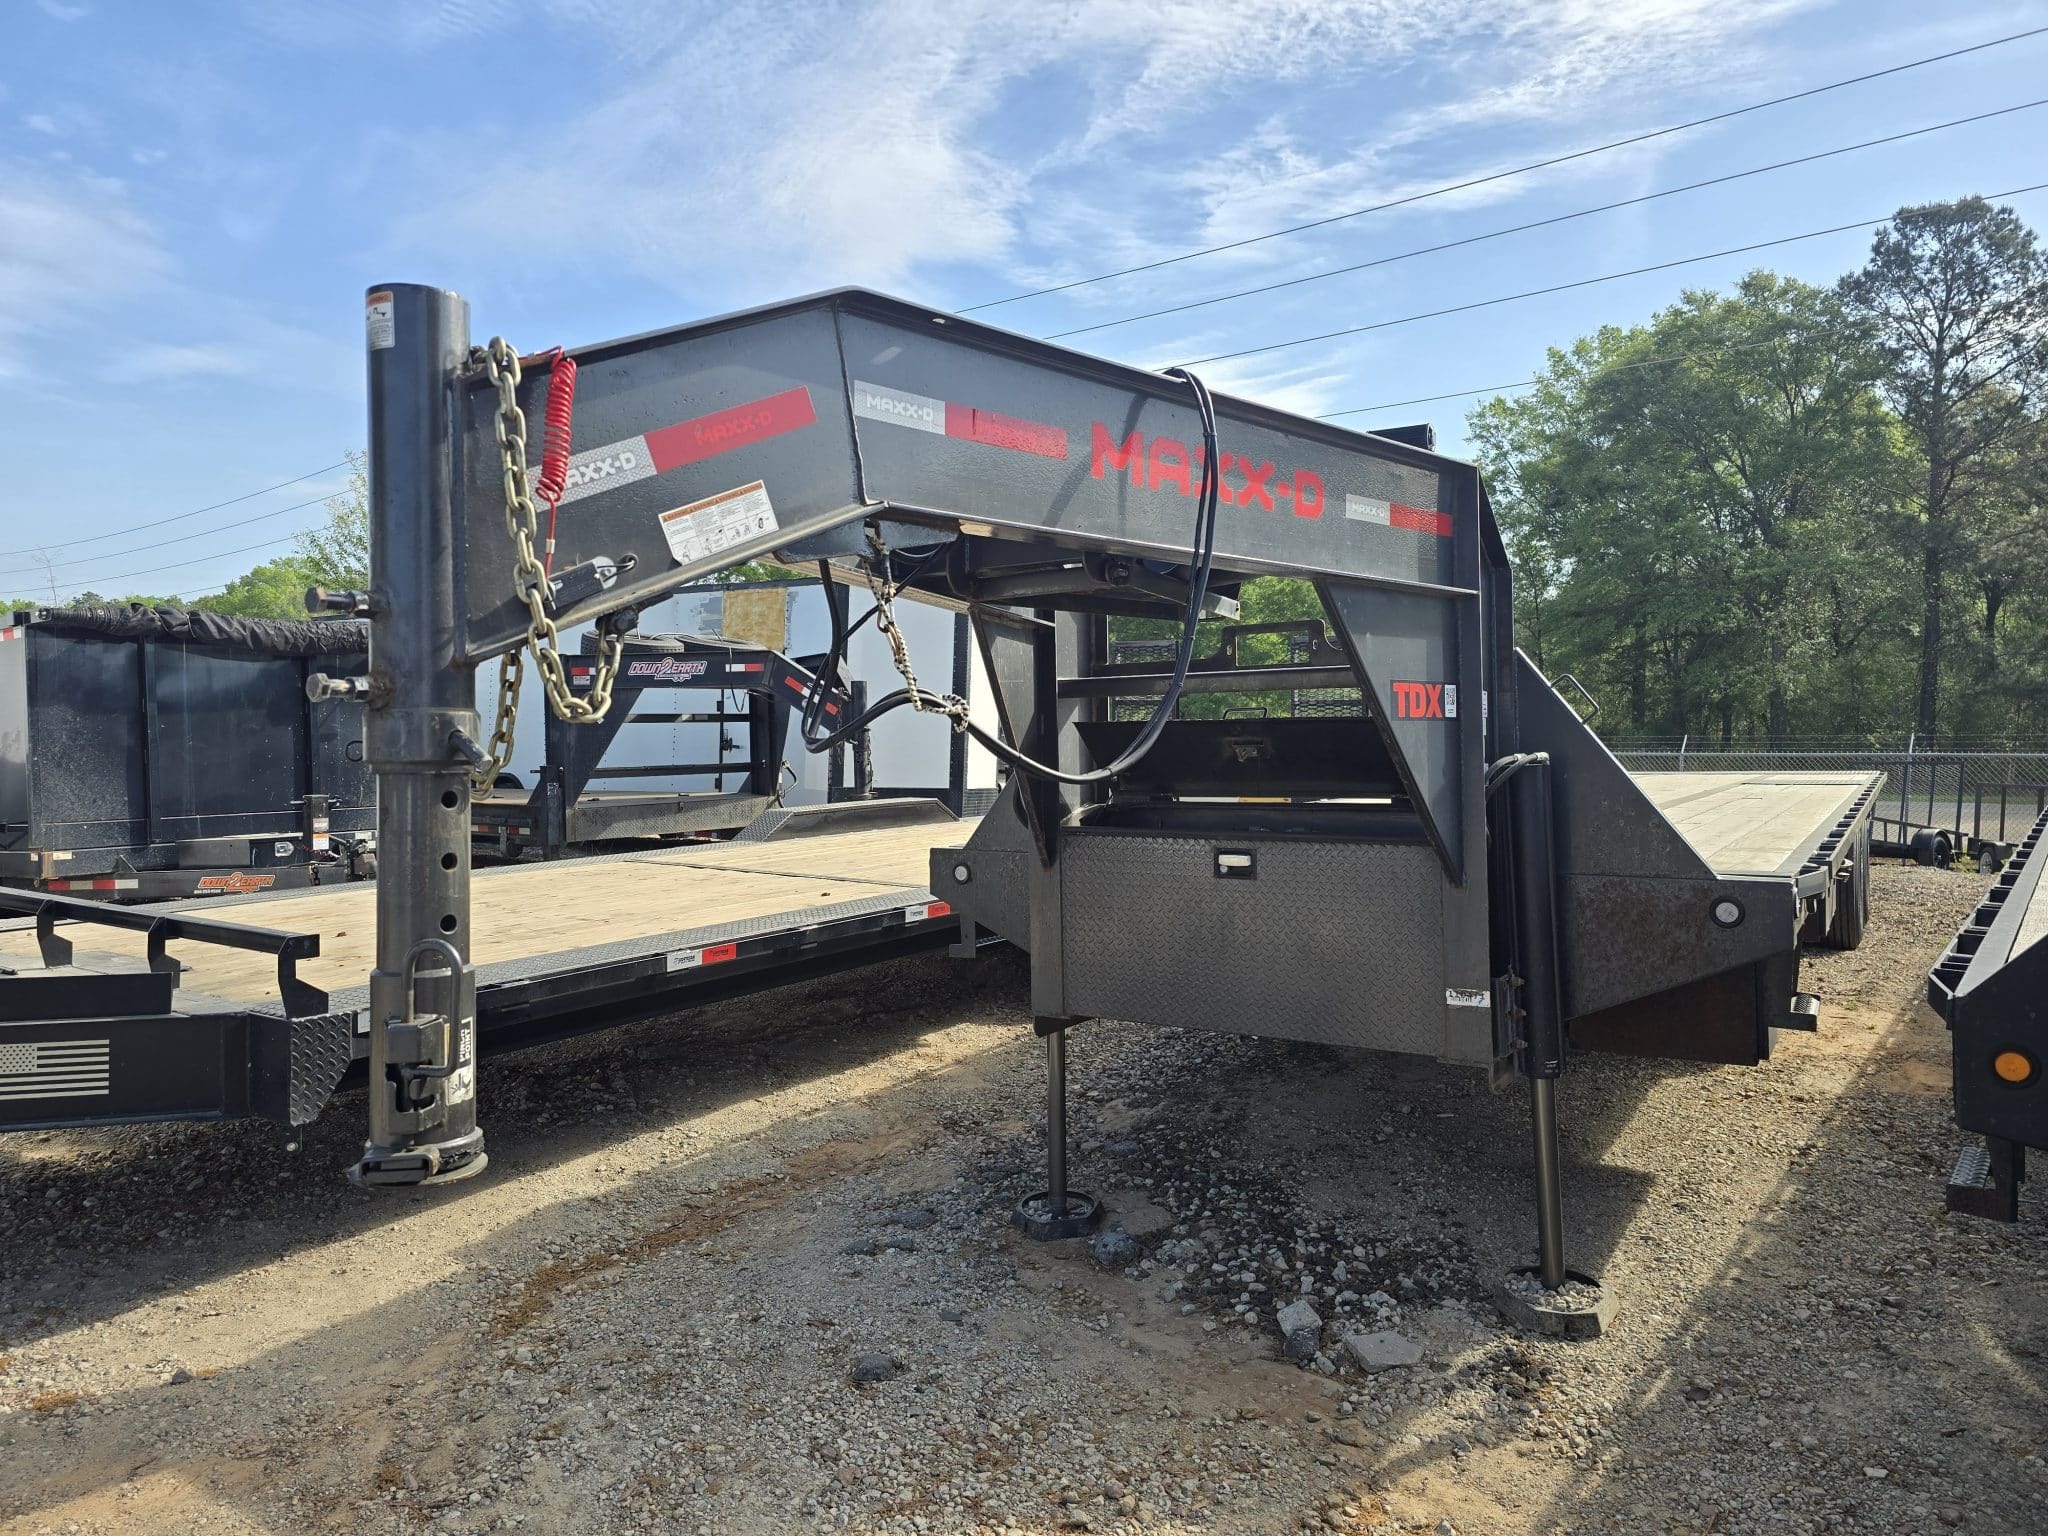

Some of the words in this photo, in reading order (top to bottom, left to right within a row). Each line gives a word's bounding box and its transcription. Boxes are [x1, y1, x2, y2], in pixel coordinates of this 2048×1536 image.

[565, 451, 638, 489] AXX-D
[1090, 420, 1326, 521] MAXX-D
[1392, 682, 1443, 718] TDX
